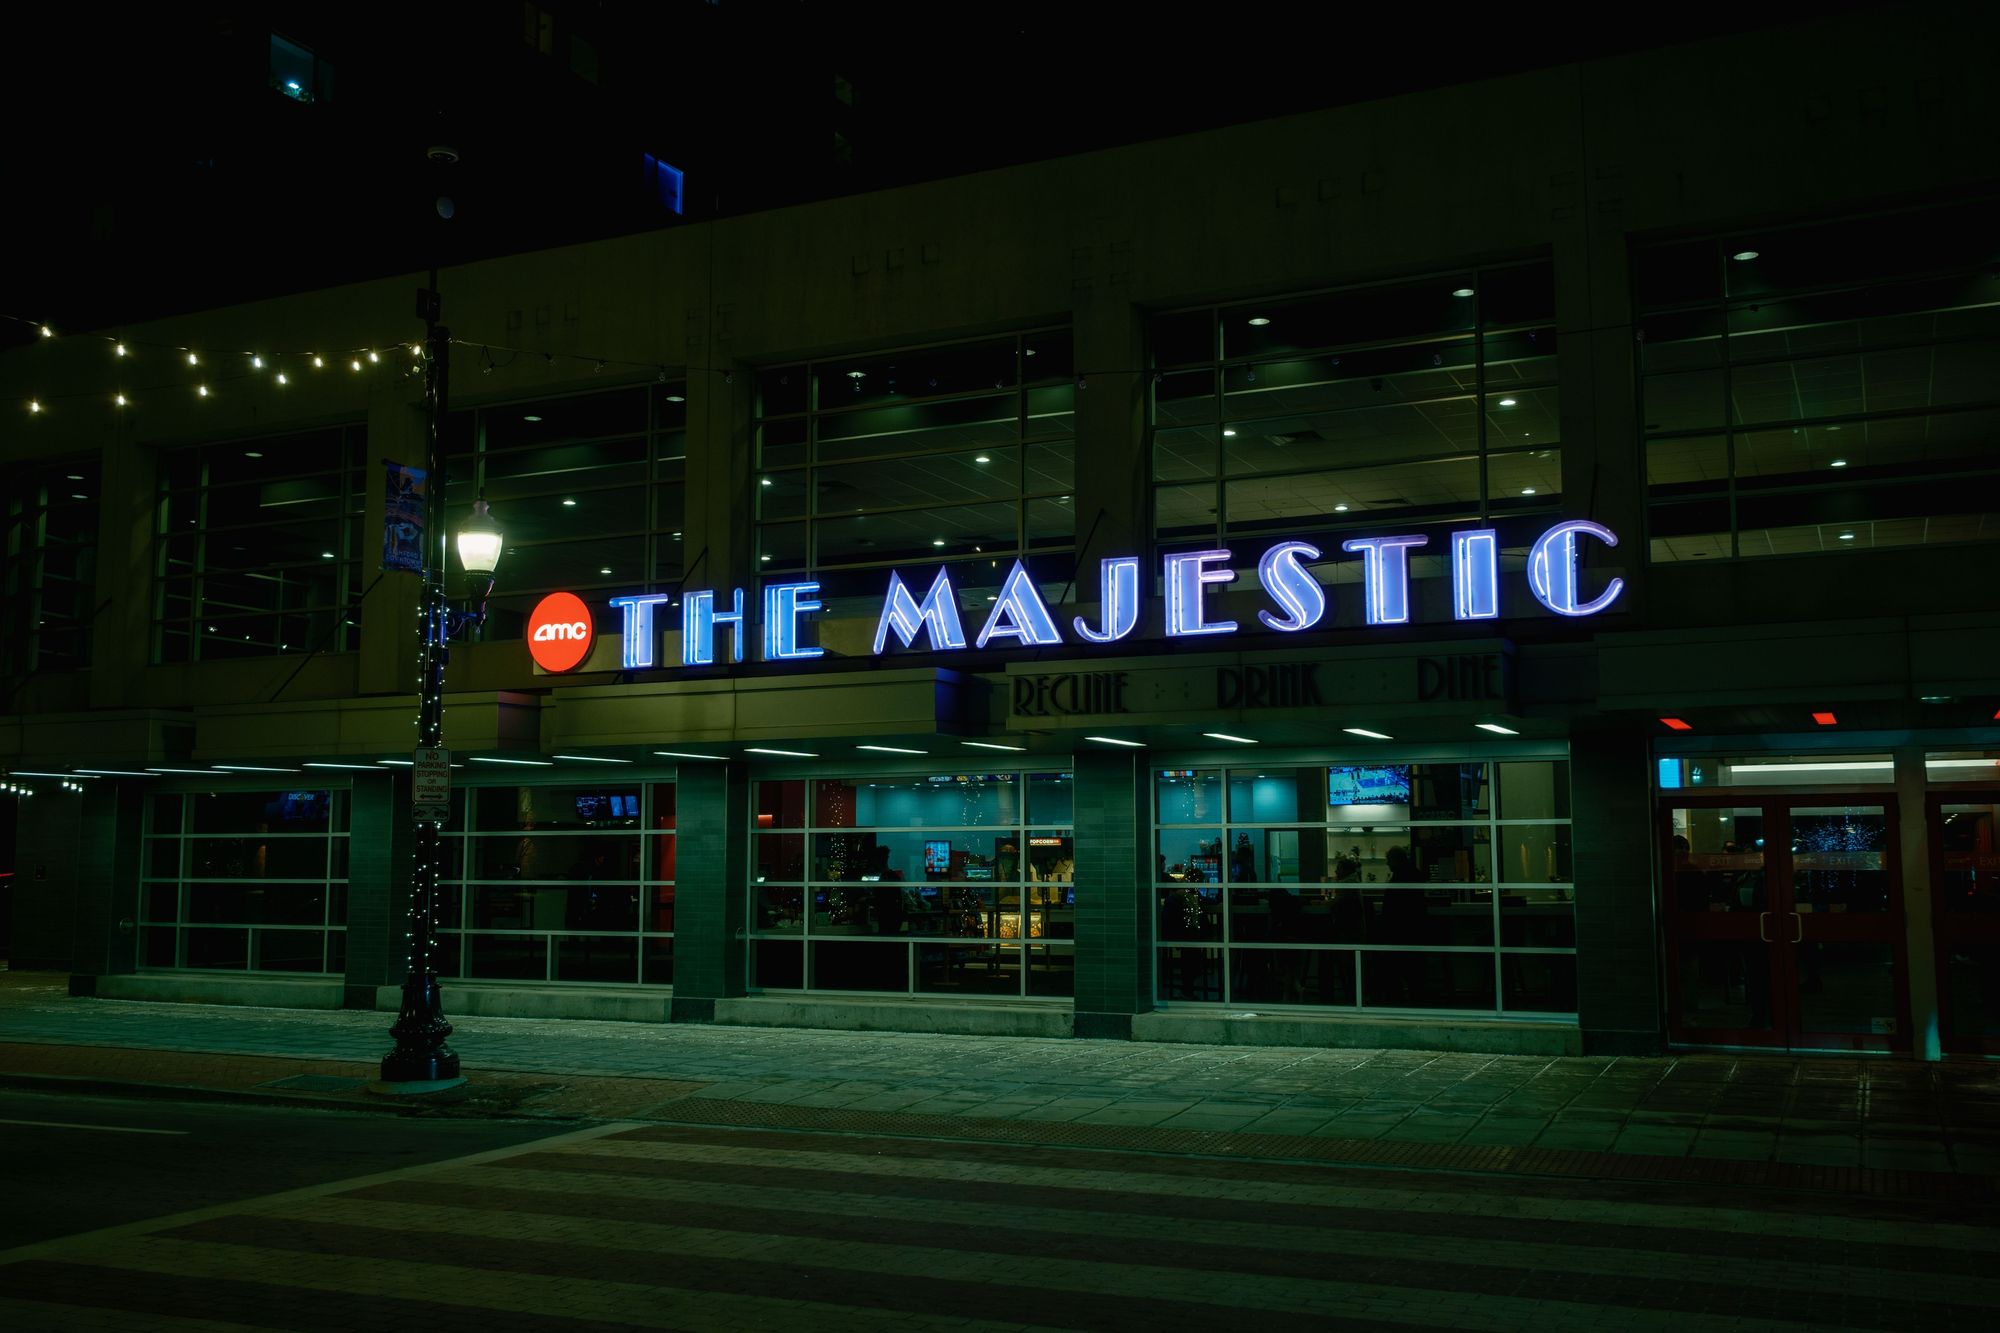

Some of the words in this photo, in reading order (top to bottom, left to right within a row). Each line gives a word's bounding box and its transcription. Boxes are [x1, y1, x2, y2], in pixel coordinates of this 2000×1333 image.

[609, 581, 825, 668] THE
[873, 520, 1624, 655] MAJESTIC
[1013, 671, 1129, 716] RECLINE
[1217, 662, 1322, 709] DRINK
[1417, 654, 1502, 701] DINE
[425, 751, 439, 760] NO
[416, 770, 448, 778] STOPPING
[416, 785, 448, 793] STANDING
